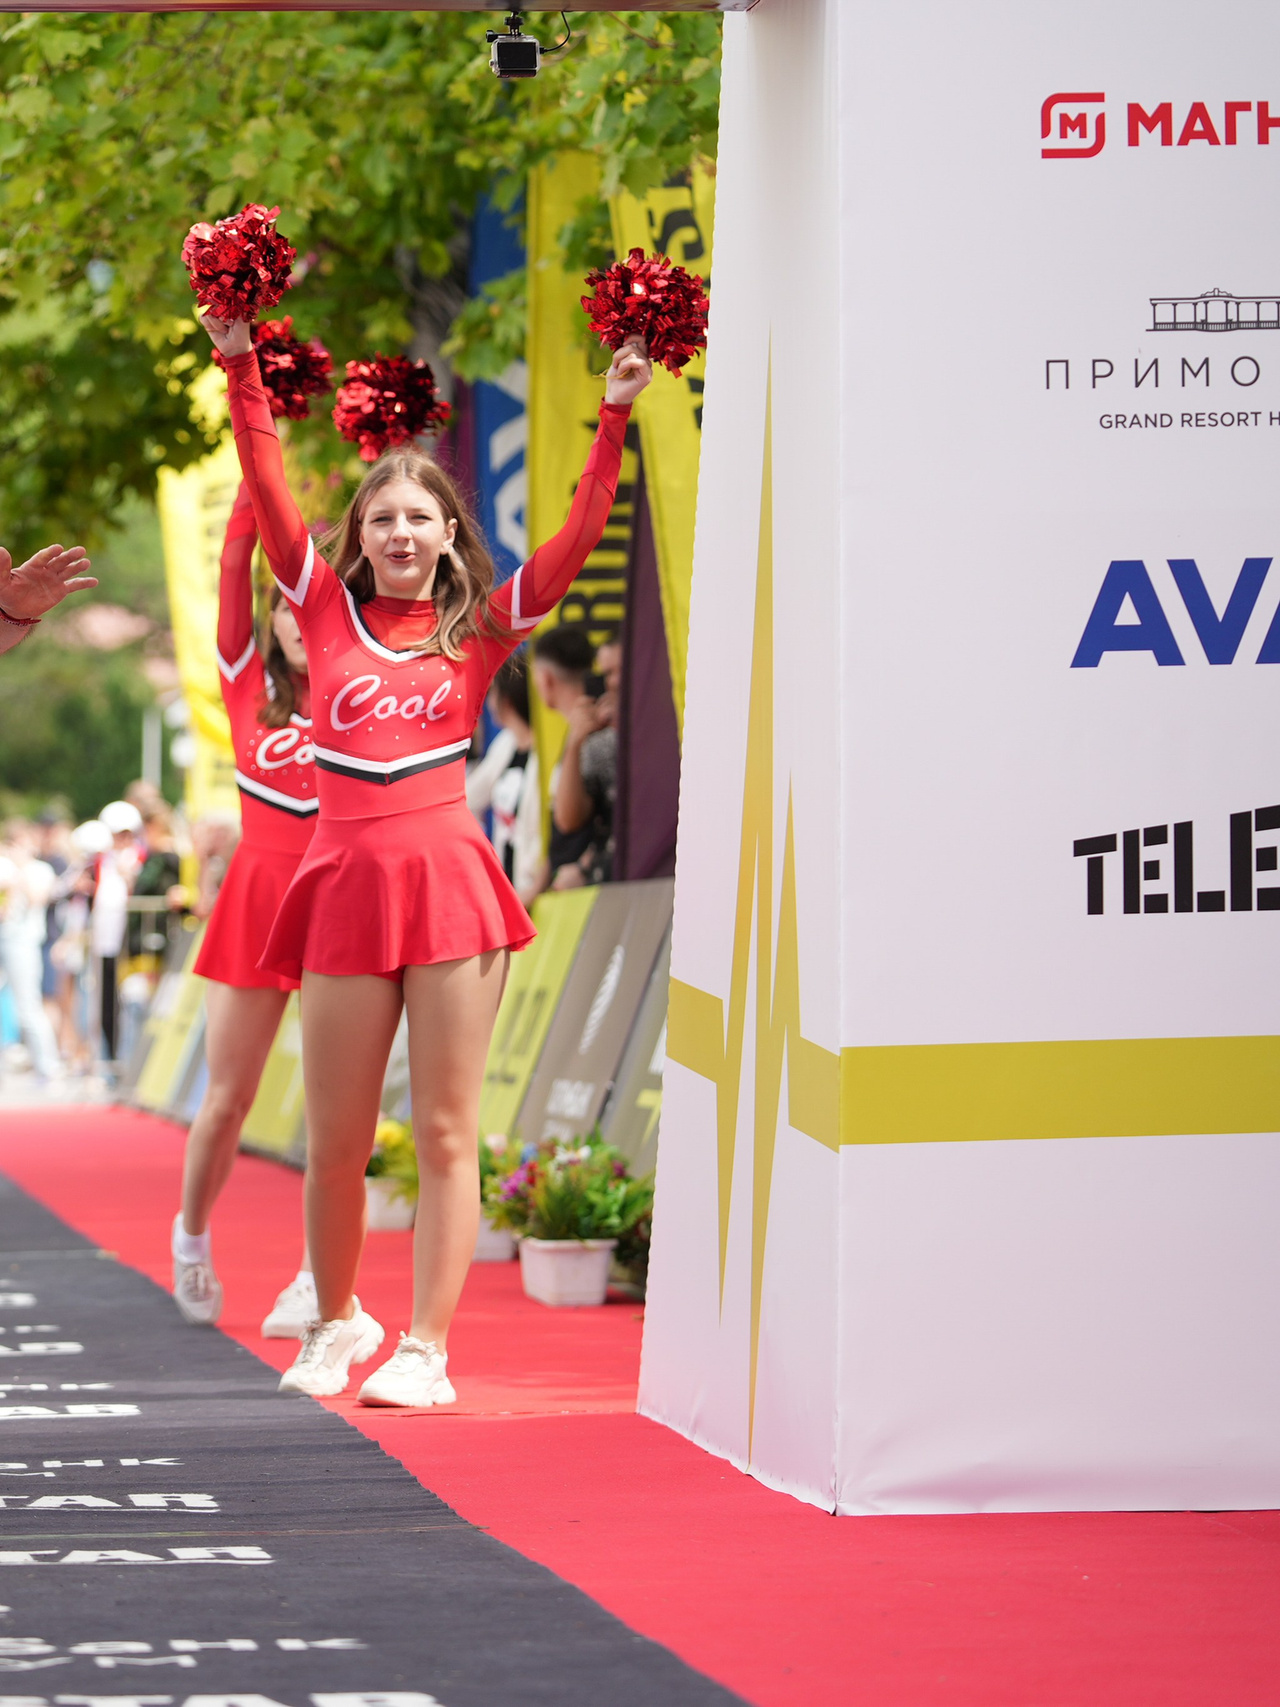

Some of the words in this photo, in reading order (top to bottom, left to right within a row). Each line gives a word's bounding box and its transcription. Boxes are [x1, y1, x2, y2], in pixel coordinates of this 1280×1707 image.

[1099, 413, 1174, 430] GRAND
[1181, 411, 1262, 428] RESORT
[1069, 556, 1280, 668] AV
[330, 674, 452, 732] Cool
[1073, 804, 1280, 915] TELE
